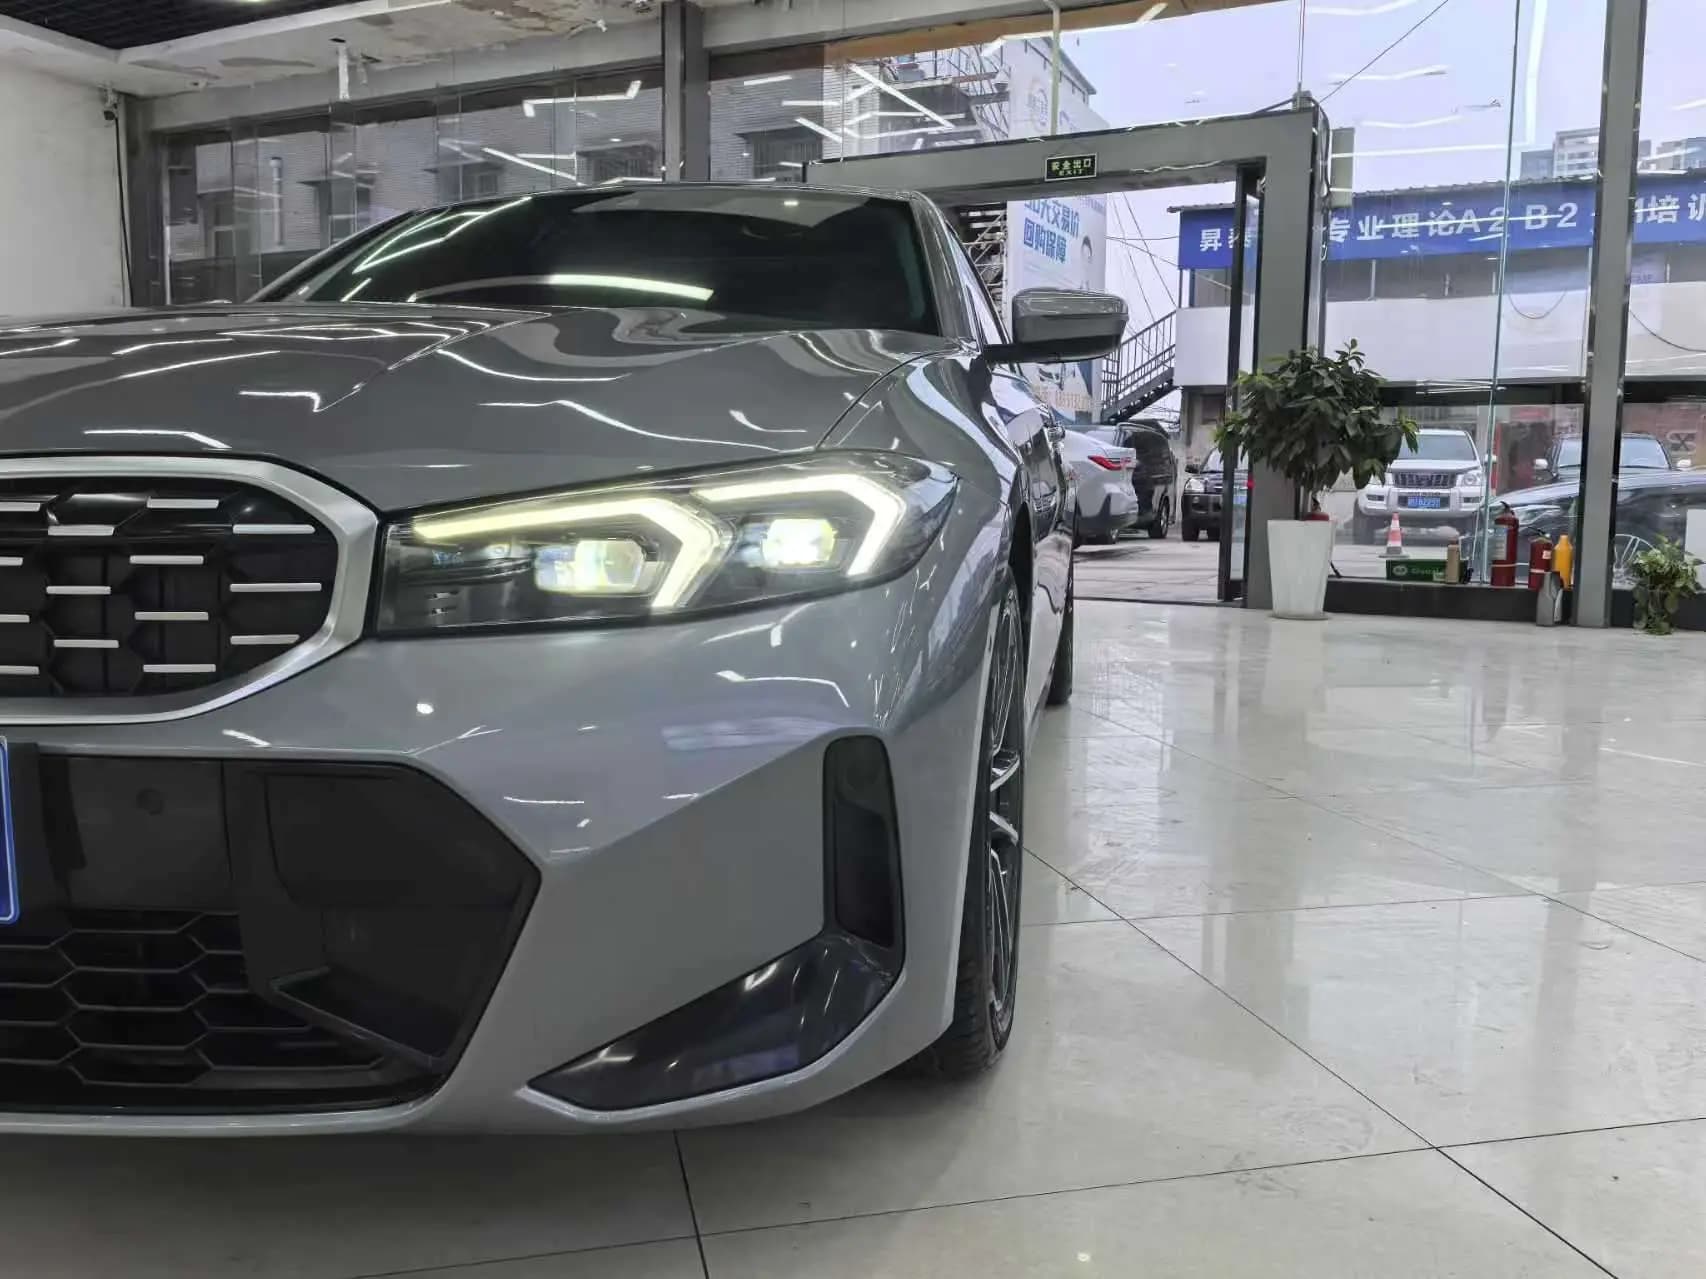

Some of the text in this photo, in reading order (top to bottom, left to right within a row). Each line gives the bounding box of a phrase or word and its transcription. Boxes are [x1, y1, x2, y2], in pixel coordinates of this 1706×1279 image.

[1058, 168, 1083, 176] EXIT
[1524, 202, 1578, 230] B2
[1024, 217, 1067, 264] 回购保障
